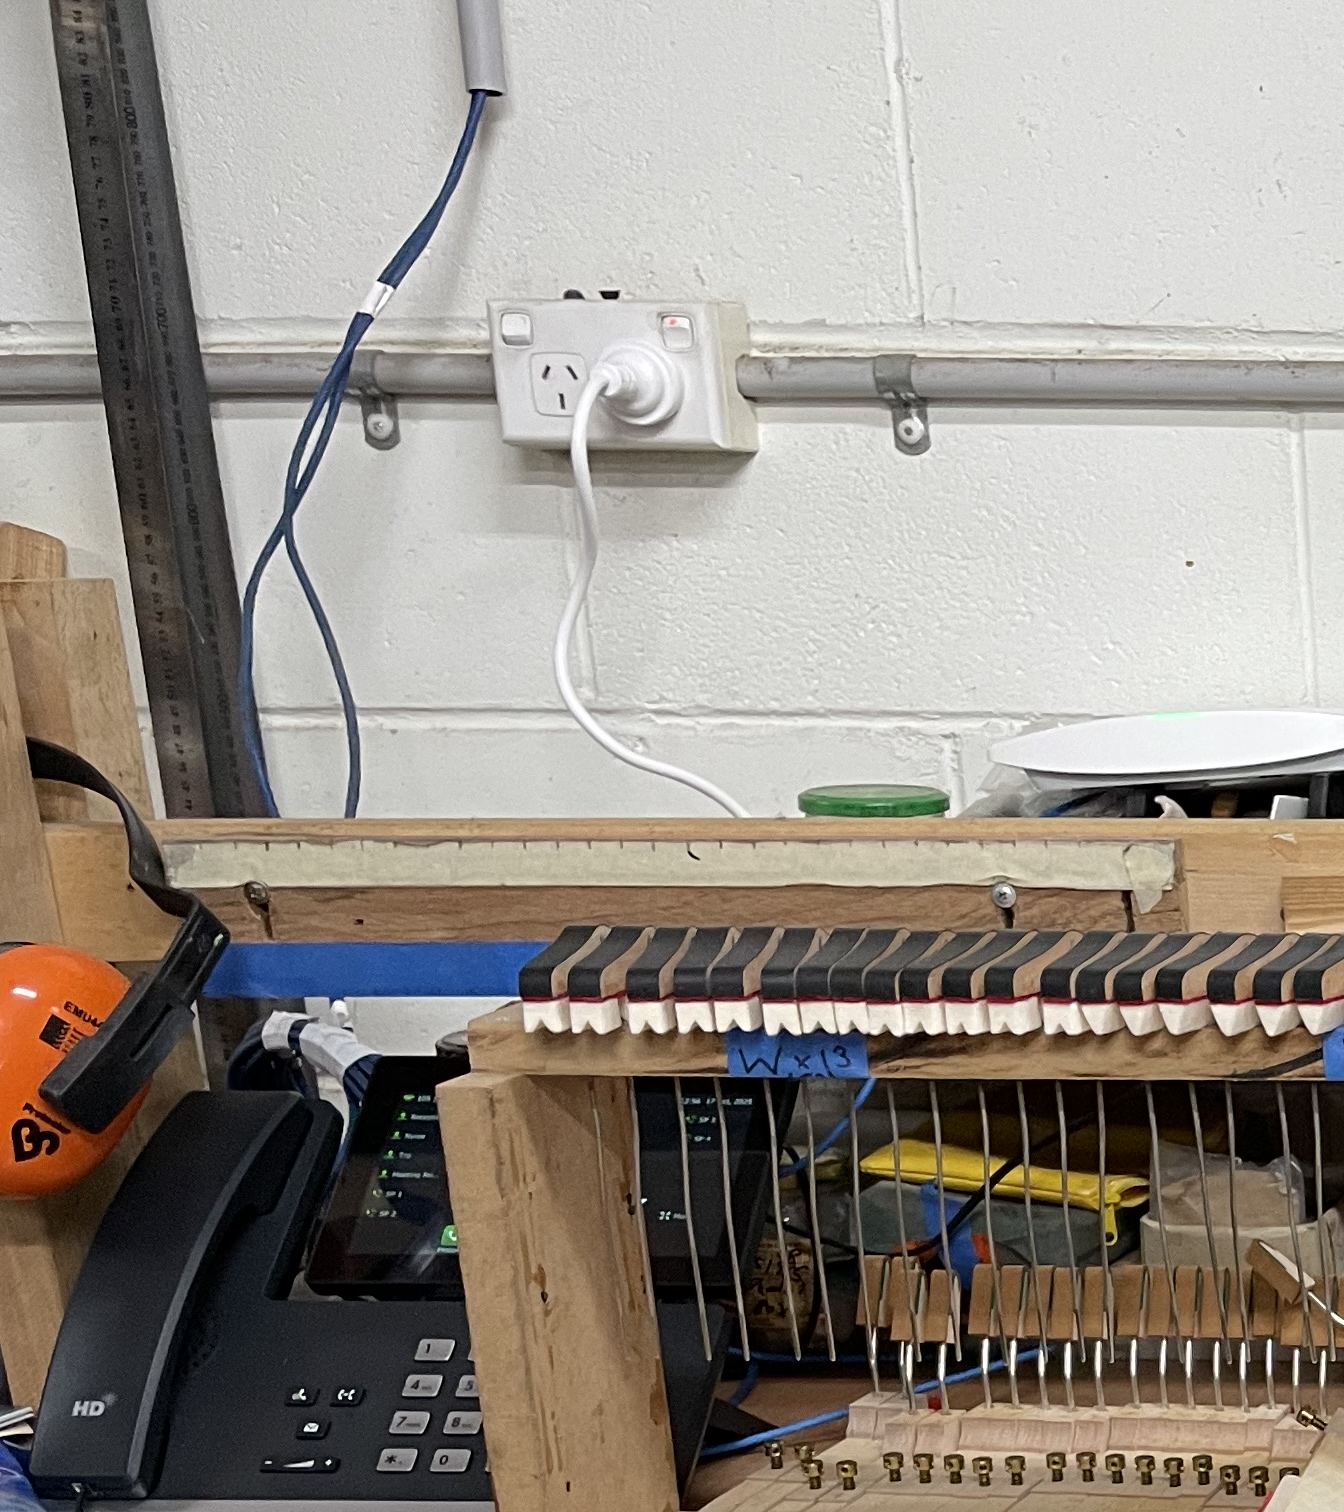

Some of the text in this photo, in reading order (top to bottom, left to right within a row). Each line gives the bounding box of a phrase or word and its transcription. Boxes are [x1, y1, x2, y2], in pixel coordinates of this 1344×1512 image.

[123, 105, 137, 130] 800
[738, 1045, 852, 1078] W x 13
[425, 1343, 431, 1354] 1
[411, 1380, 420, 1389] 4
[464, 1380, 474, 1391] 5
[71, 1400, 106, 1417] HD
[396, 1416, 408, 1428] 7
[451, 1416, 461, 1428] 8
[439, 1455, 449, 1465] 0
